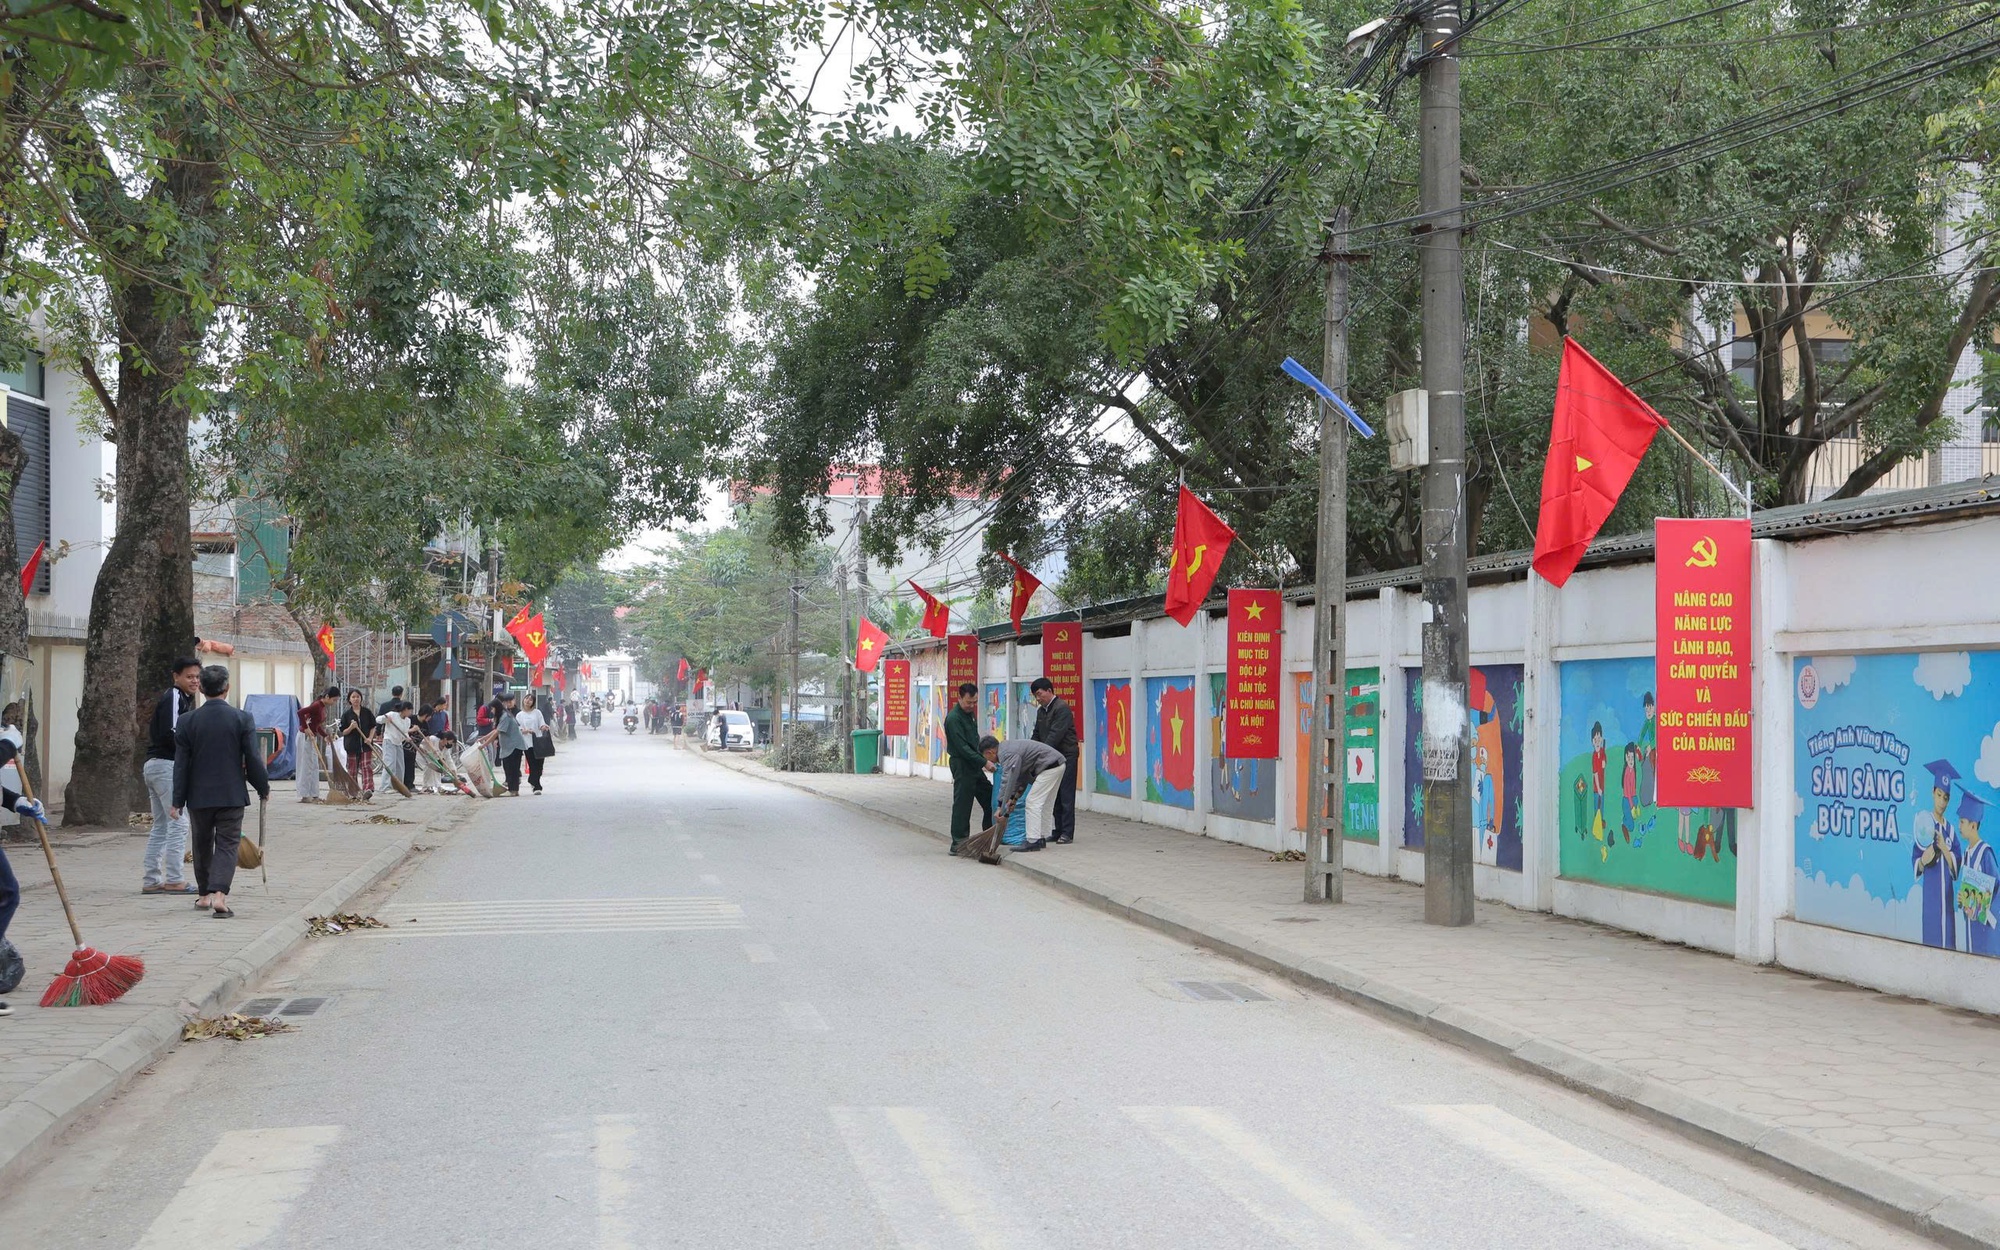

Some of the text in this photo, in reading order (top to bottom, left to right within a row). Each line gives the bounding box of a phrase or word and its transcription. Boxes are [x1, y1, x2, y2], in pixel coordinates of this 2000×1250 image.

[1674, 591, 1734, 607] NÂNG CAO
[1674, 615, 1732, 634] NĂNG LỰC
[1254, 632, 1270, 645] ĐỊNH
[1238, 649, 1253, 661] MỤC
[1674, 639, 1733, 658] LÃNH ĐẠO,
[1239, 664, 1267, 678] ĐỘC LẬP
[1670, 661, 1738, 680] CẦM QUYỀN
[1254, 681, 1267, 695] TỘC
[1696, 687, 1712, 703] VÀ
[1230, 697, 1276, 711] VÀ CHỦ NGHĨA
[1250, 715, 1265, 729] HỘI!
[1659, 710, 1748, 728] SỨC CHIẾN ĐẤU
[1672, 733, 1735, 751] CỦA ĐẢNG!
[1806, 726, 1910, 764] Tiếng Anh Vững Vàng
[1811, 758, 1905, 801] SẴN SÀNG
[1817, 802, 1900, 842] BỨT PHÁ
